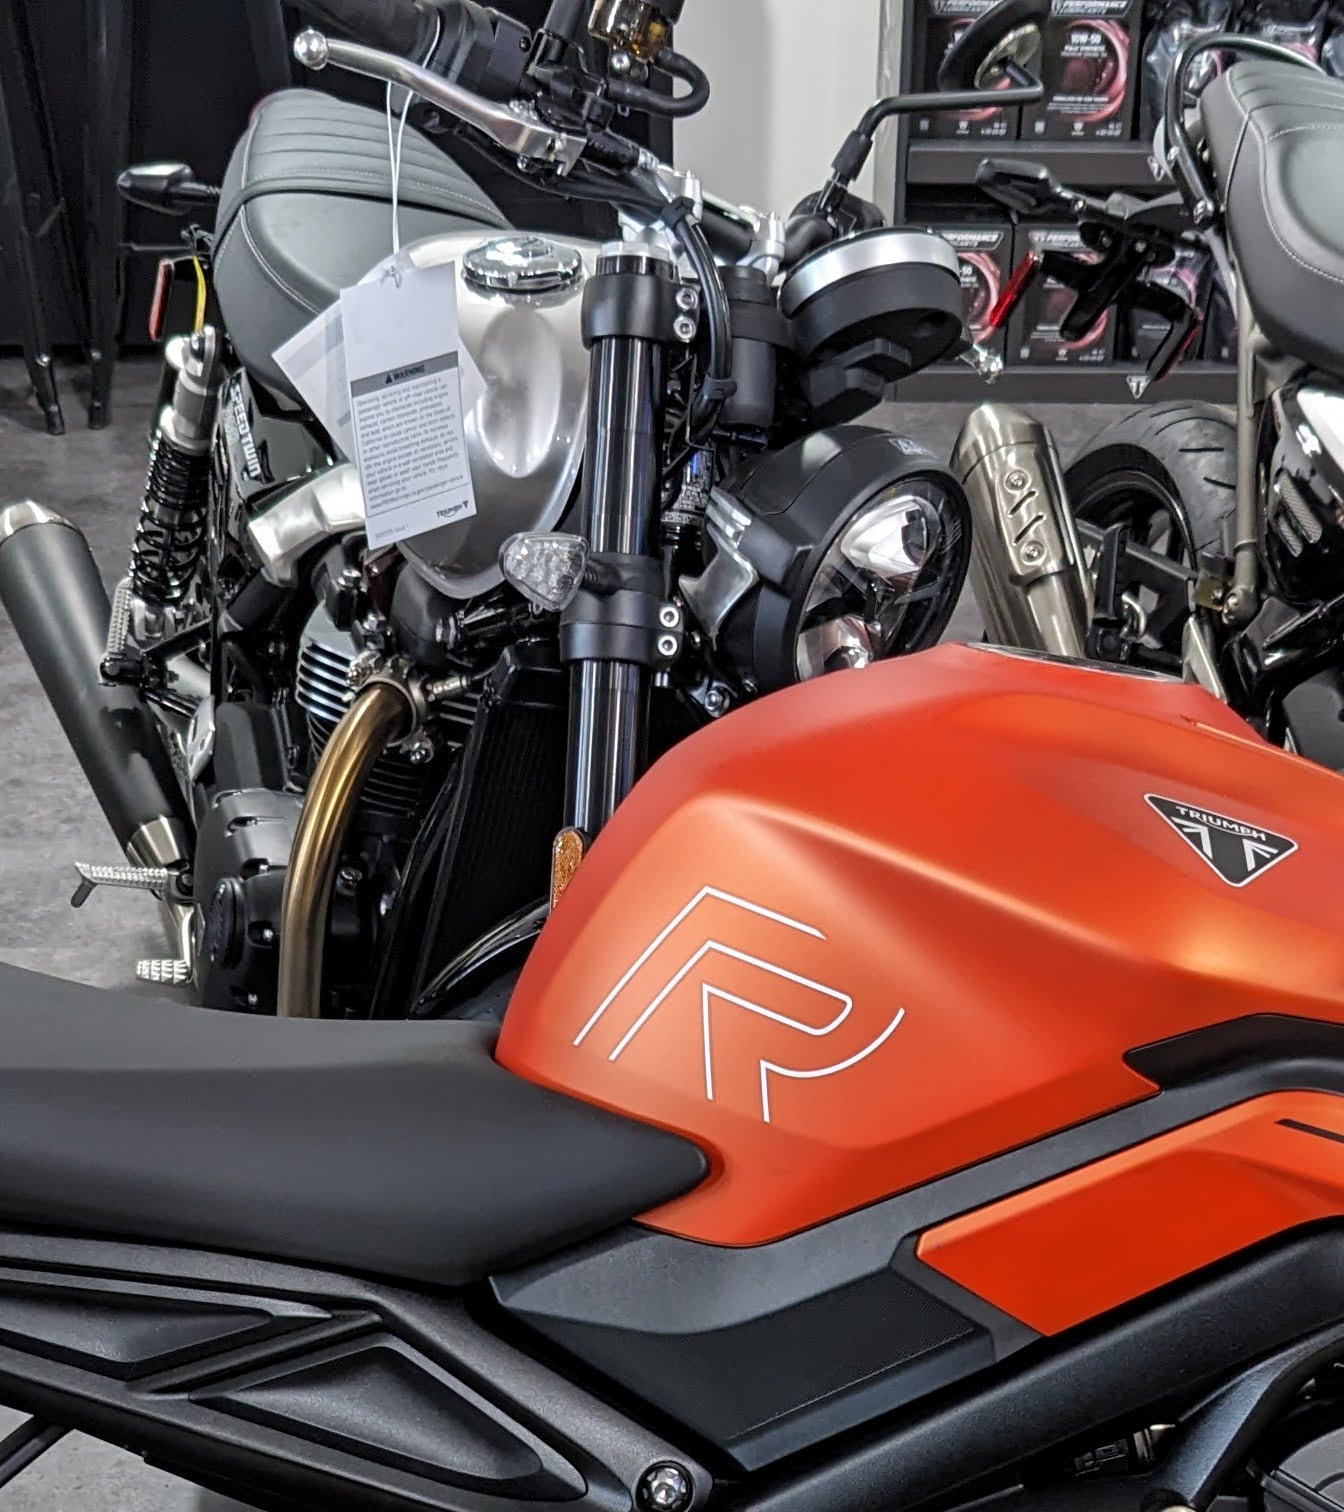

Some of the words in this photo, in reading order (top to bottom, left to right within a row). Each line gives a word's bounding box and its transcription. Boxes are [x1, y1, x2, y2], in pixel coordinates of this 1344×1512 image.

[230, 383, 250, 436] SPEED
[241, 433, 262, 478] TWIN
[1175, 805, 1267, 842] TRIUMPH
